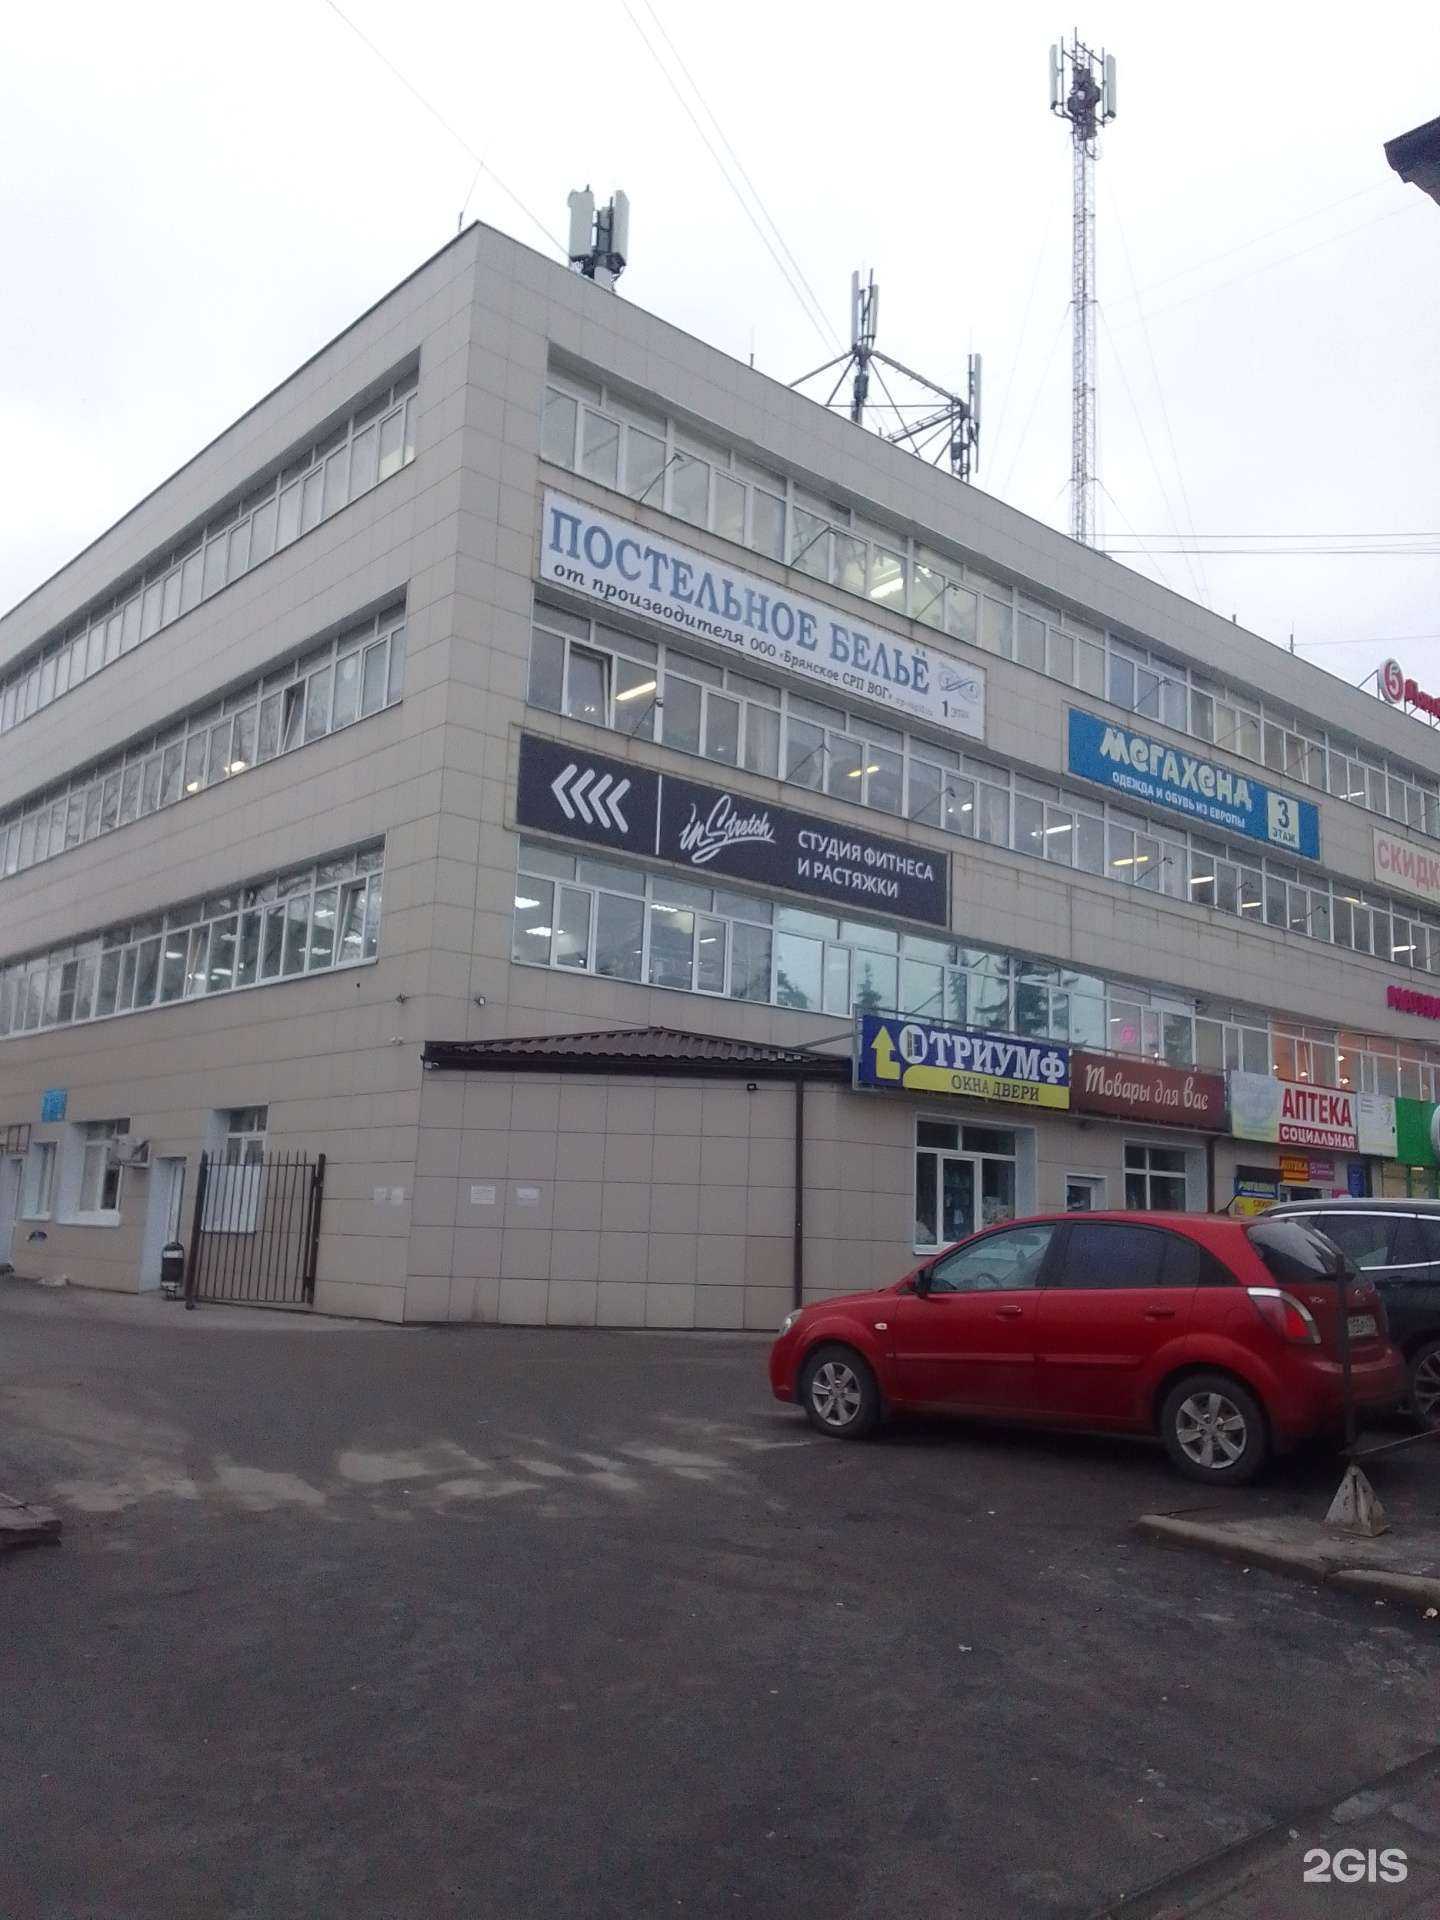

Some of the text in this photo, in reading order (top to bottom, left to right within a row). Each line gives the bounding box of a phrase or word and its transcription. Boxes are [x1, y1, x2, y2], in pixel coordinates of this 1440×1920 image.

[549, 507, 930, 694] ПОСТЕЛЬНОЕ БЕЛЬЁ
[554, 564, 585, 585] от
[592, 577, 745, 646] производителя
[750, 637, 777, 657] ООО
[842, 672, 865, 689] СРП
[942, 700, 949, 718] 1
[1112, 771, 1245, 828] ОДЕЖДА И ОБУВЬ ИЗ ЕВРОПЫ
[1277, 799, 1290, 829] 3
[798, 831, 934, 881] СТУДИЯ ФИТНЕСА
[797, 857, 899, 898] И РАСТЯЖКИ
[951, 1074, 1040, 1101] ОКНА ДВЕРИ
[1085, 1063, 1151, 1104] Товары
[1154, 1079, 1179, 1106] для
[1282, 1088, 1353, 1127] АПТЕКА
[1281, 1125, 1355, 1149] СОЦИАЛЬНАЯ
